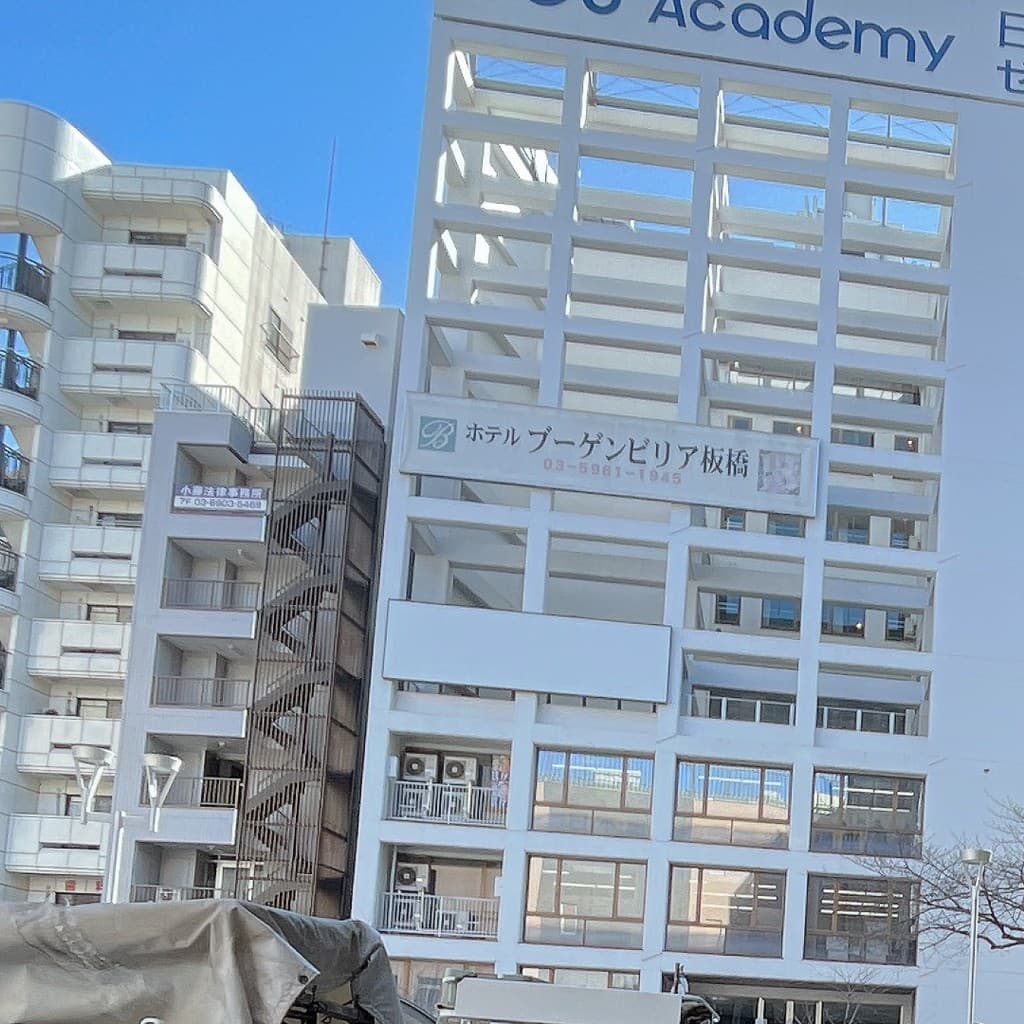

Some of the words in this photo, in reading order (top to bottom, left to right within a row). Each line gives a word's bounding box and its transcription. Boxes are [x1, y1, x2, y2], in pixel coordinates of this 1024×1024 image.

[647, 0, 956, 72] Academy
[465, 422, 521, 447] ホテル
[528, 426, 750, 478] ブーゲンビリア板橋
